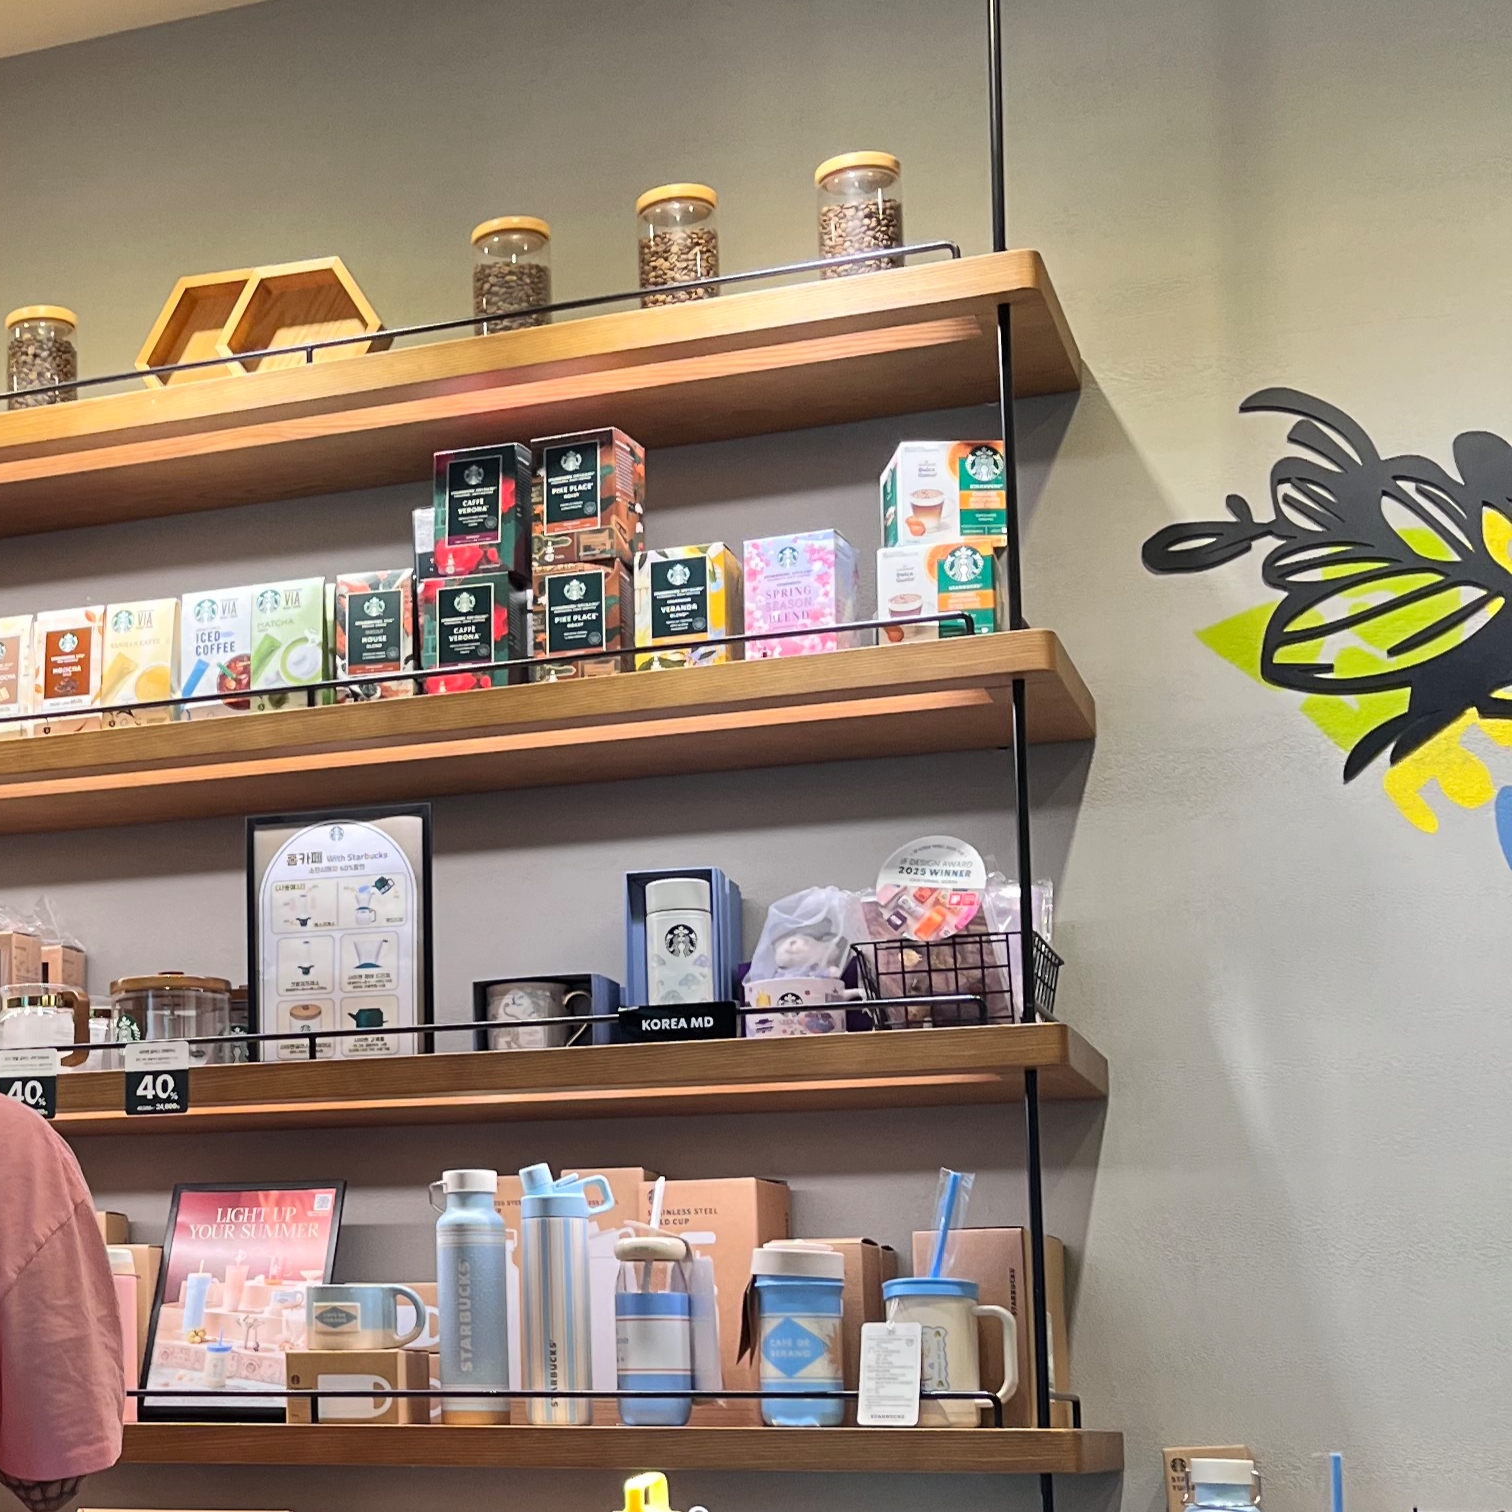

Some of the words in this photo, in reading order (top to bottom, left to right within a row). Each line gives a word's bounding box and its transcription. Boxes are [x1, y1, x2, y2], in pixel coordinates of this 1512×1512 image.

[284, 590, 300, 606] VIA
[765, 585, 812, 599] SPRING
[221, 600, 237, 616] VIA
[766, 597, 812, 612] SEASON
[137, 611, 152, 626] VIA
[257, 618, 295, 629] MATCHA
[572, 613, 596, 621] PLACE
[769, 610, 809, 624] BLEND
[110, 639, 138, 649] VANILLA
[139, 638, 160, 647] LATTE
[196, 630, 221, 643] ICED
[361, 635, 387, 643] HOUSE
[195, 641, 235, 656] COFFEE
[287, 851, 323, 866] 홈카페
[348, 851, 388, 861] Starbucks
[909, 859, 941, 867] DESIGN
[942, 860, 973, 868] AWARD
[929, 868, 972, 878] WINNER
[641, 1017, 687, 1031] KOREA
[690, 1016, 714, 1028] MD
[136, 1073, 179, 1100] 40%
[216, 1207, 265, 1223] LIGHT
[273, 1206, 297, 1222] UP
[647, 1208, 691, 1216] SAINLESS
[694, 1207, 718, 1215] STEEL
[189, 1224, 235, 1239] YOUR
[240, 1222, 319, 1239] SUMMER
[460, 1260, 473, 1373] STARBUCKS
[550, 1339, 558, 1408] SARBUCKS
